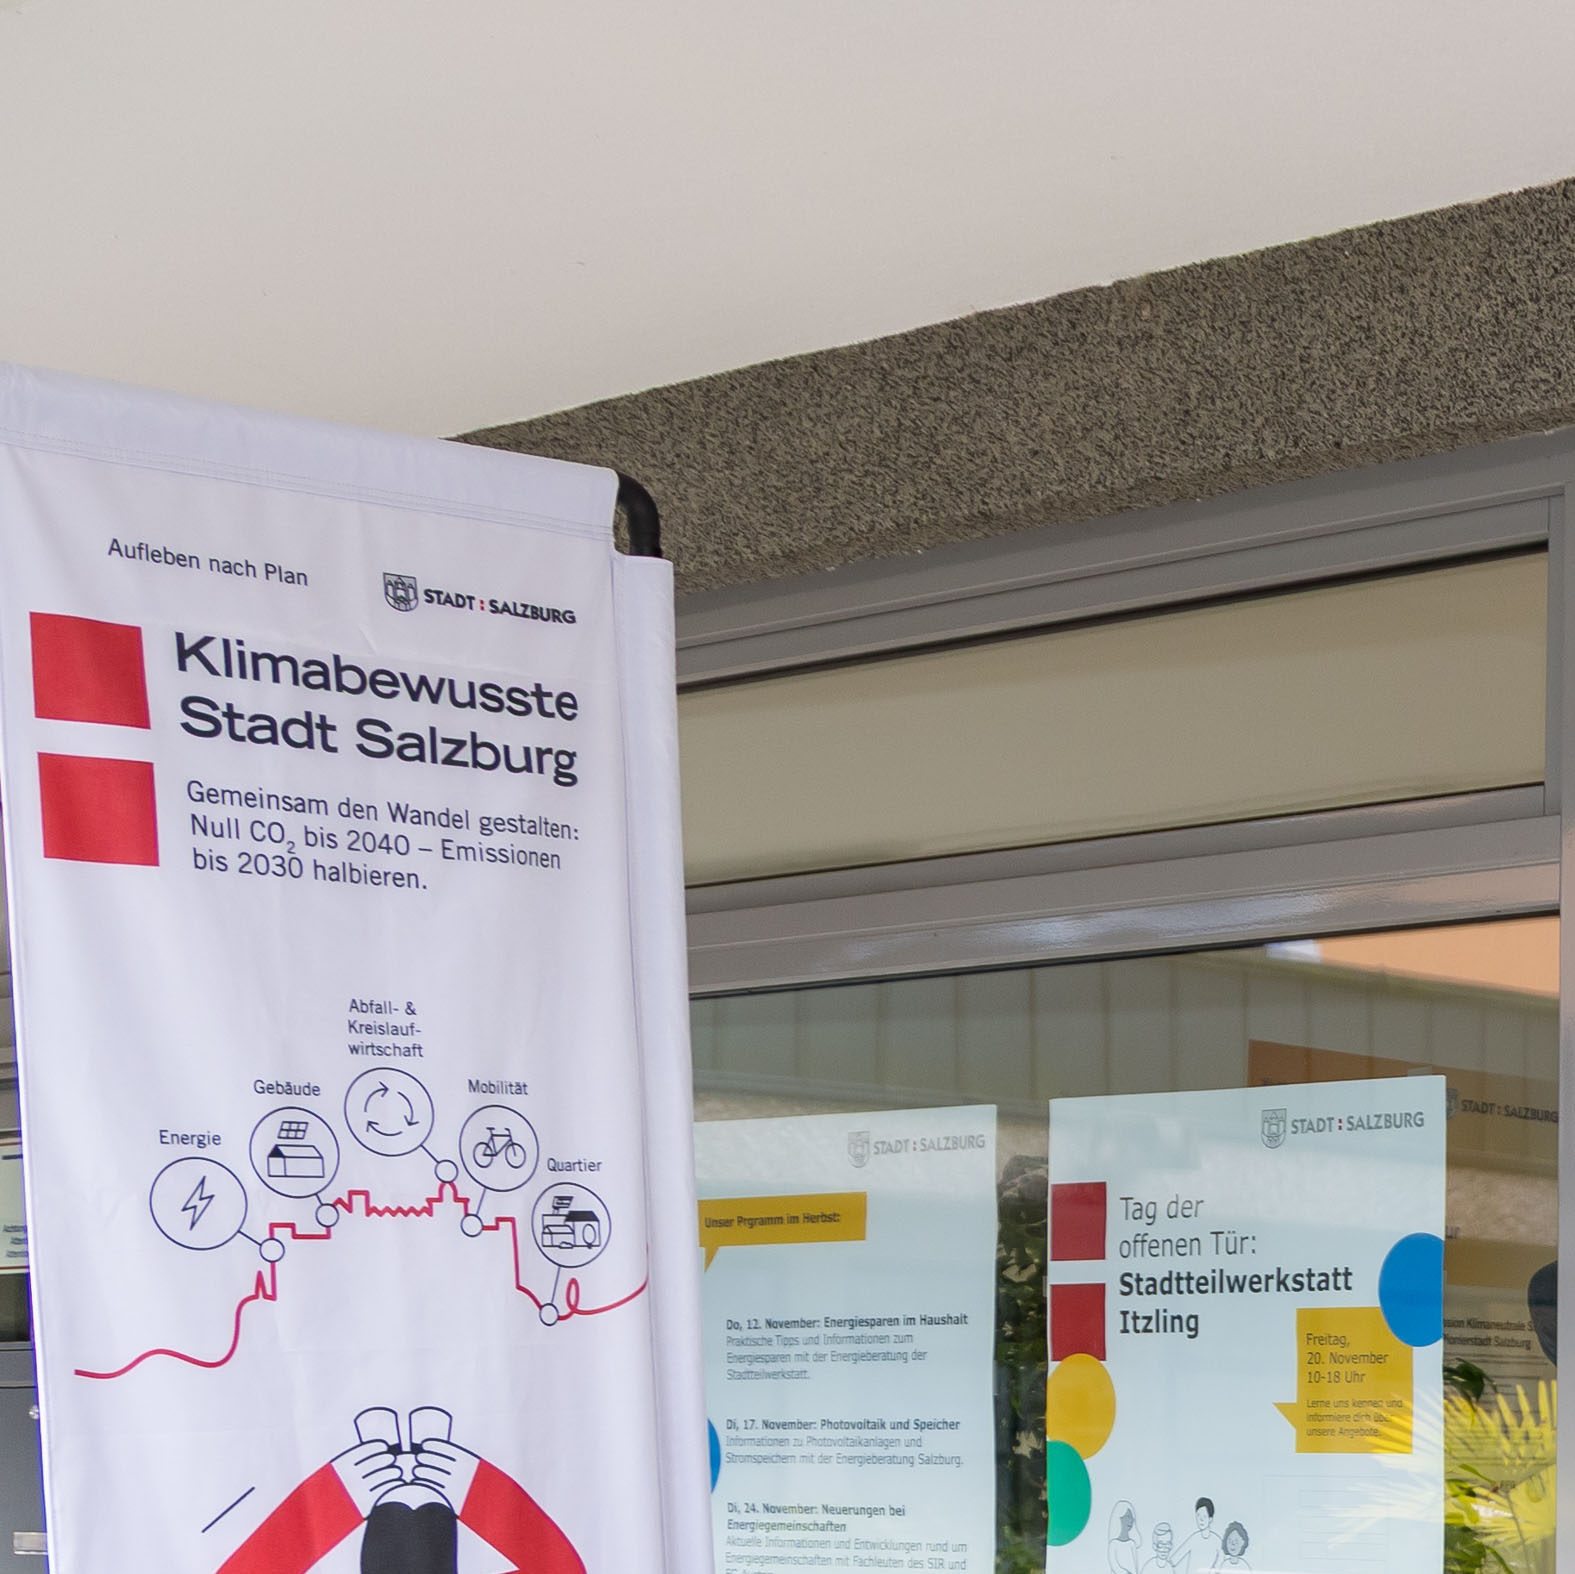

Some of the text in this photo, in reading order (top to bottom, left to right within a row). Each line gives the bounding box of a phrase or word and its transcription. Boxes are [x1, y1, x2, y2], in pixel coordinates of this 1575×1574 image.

[108, 538, 308, 586] Aufleben nach Plan
[423, 588, 476, 610] STADT
[488, 599, 577, 624] SALZBURG
[175, 631, 578, 722] Klimabewusste
[180, 695, 578, 787] Stadt Salzburg
[187, 780, 580, 841] Gemeinsam den Wandel gestalten:
[190, 814, 241, 840] Null
[304, 825, 339, 849] bis
[347, 830, 411, 856] 2040
[441, 839, 561, 870] Emissionen
[192, 848, 428, 890] bis 2030 halbieren.
[349, 998, 417, 1017] Abfall- &
[347, 1020, 422, 1038] Kreislauf-
[348, 1041, 424, 1059] wirtschaft
[253, 1079, 321, 1097] Gebäude
[467, 1078, 529, 1097] Mobilität
[1461, 1099, 1495, 1115] STADT
[1504, 1104, 1559, 1124] SALZBURG
[1291, 1117, 1335, 1134] STADT
[1346, 1111, 1424, 1131] SALZBURG
[159, 1129, 222, 1149] Energie
[873, 1138, 909, 1155] STADT
[920, 1134, 986, 1152] SALZBURG
[546, 1158, 603, 1175] Quartier
[1119, 1194, 1205, 1226] Tag der
[704, 1217, 734, 1228] Unser
[787, 1213, 799, 1224] im
[802, 1212, 841, 1223] Herbst:
[1119, 1230, 1256, 1259] offenen Tür:
[1119, 1267, 1353, 1297] Stadtteilwerkstatt
[726, 1313, 968, 1332] Do, 12. November: Energiesparen im Haushalt
[1119, 1308, 1199, 1339] Itzling
[726, 1333, 914, 1348] Praktische Tipps und Informationen zum
[1306, 1333, 1350, 1348] Freitag,
[1494, 1336, 1531, 1351] Salzburg
[726, 1349, 927, 1366] Energiesparen mit der Energieberatung der
[1307, 1352, 1389, 1365] 20. November
[1307, 1370, 1366, 1383] 10-18 Uhr
[726, 1418, 960, 1432] Di, 17. November: Photovoltaik und Speicher
[726, 1435, 789, 1447] Informationen
[806, 1435, 900, 1449] Photovoltaikanlagen
[904, 1436, 922, 1448] und
[800, 1452, 814, 1464] mit
[817, 1452, 832, 1464] der
[836, 1453, 914, 1467] Energieberatung
[918, 1453, 964, 1467] Salzburg.
[728, 1503, 905, 1518] Di, 24. November: Neuerungen bei
[727, 1519, 847, 1534] Energiegemeinschaften
[834, 1537, 850, 1549] und
[854, 1538, 922, 1553] Entwicklungen
[925, 1539, 948, 1551] rund
[951, 1542, 967, 1552] um
[908, 1557, 924, 1569] des
[949, 1558, 967, 1570] und
